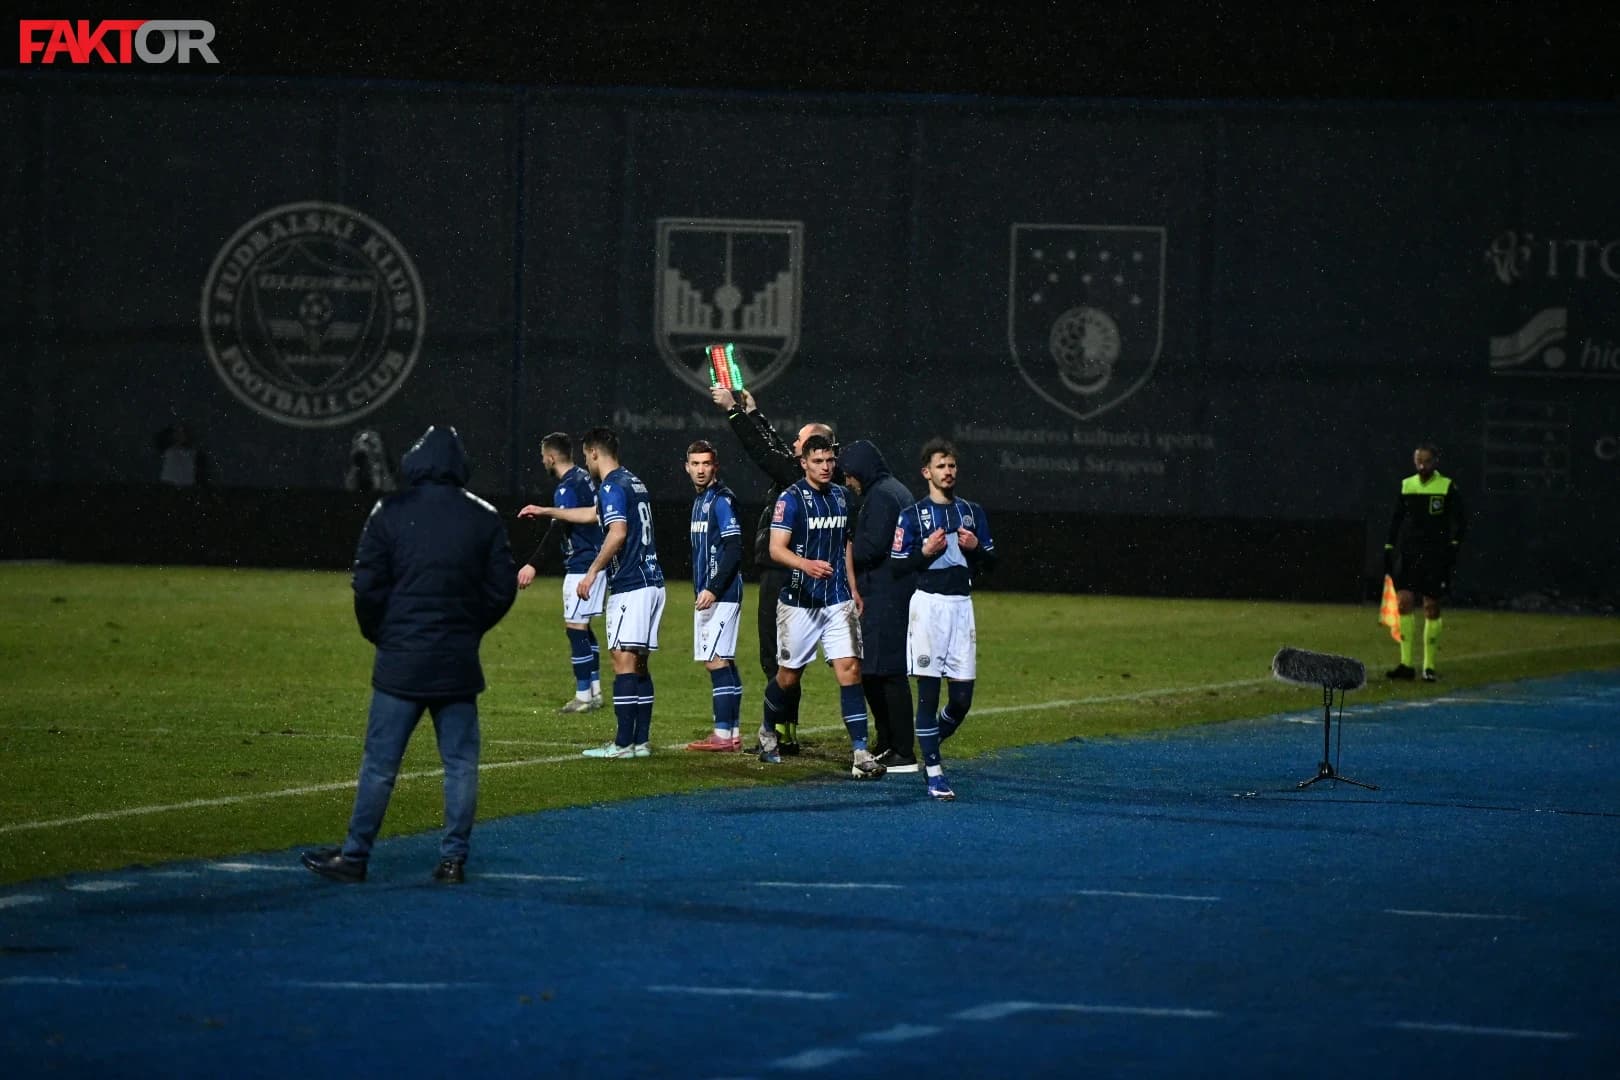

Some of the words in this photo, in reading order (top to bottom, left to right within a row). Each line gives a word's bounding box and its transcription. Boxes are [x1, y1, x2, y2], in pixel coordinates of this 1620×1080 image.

[214, 211, 356, 303] FUDBALSKI
[360, 234, 412, 312] KLUB
[221, 345, 344, 416] FOOTBALL
[346, 350, 405, 406] CLUB
